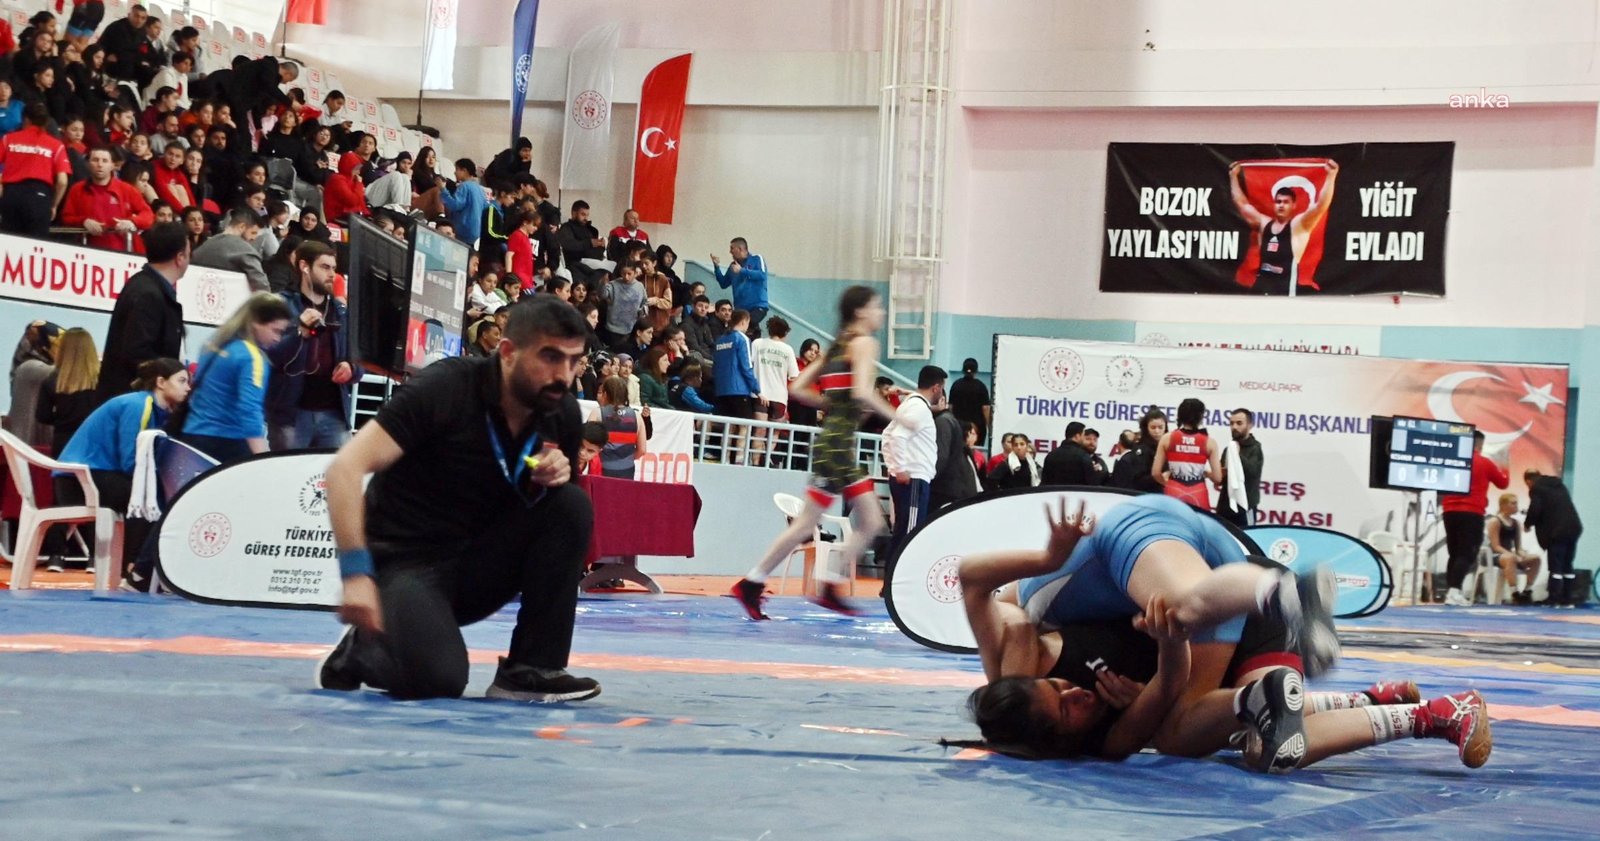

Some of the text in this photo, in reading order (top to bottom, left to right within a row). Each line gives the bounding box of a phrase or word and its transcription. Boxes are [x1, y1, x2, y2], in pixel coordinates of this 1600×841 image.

[1139, 186, 1213, 217] BOZOK
[1359, 181, 1418, 218] YİĞİT
[1345, 231, 1425, 261] EVLADI
[1016, 395, 1090, 419] TÜRKİYE
[1422, 468, 1439, 484] 18
[285, 525, 334, 541] TÜRKİYE
[244, 541, 281, 558] GÜREŞ
